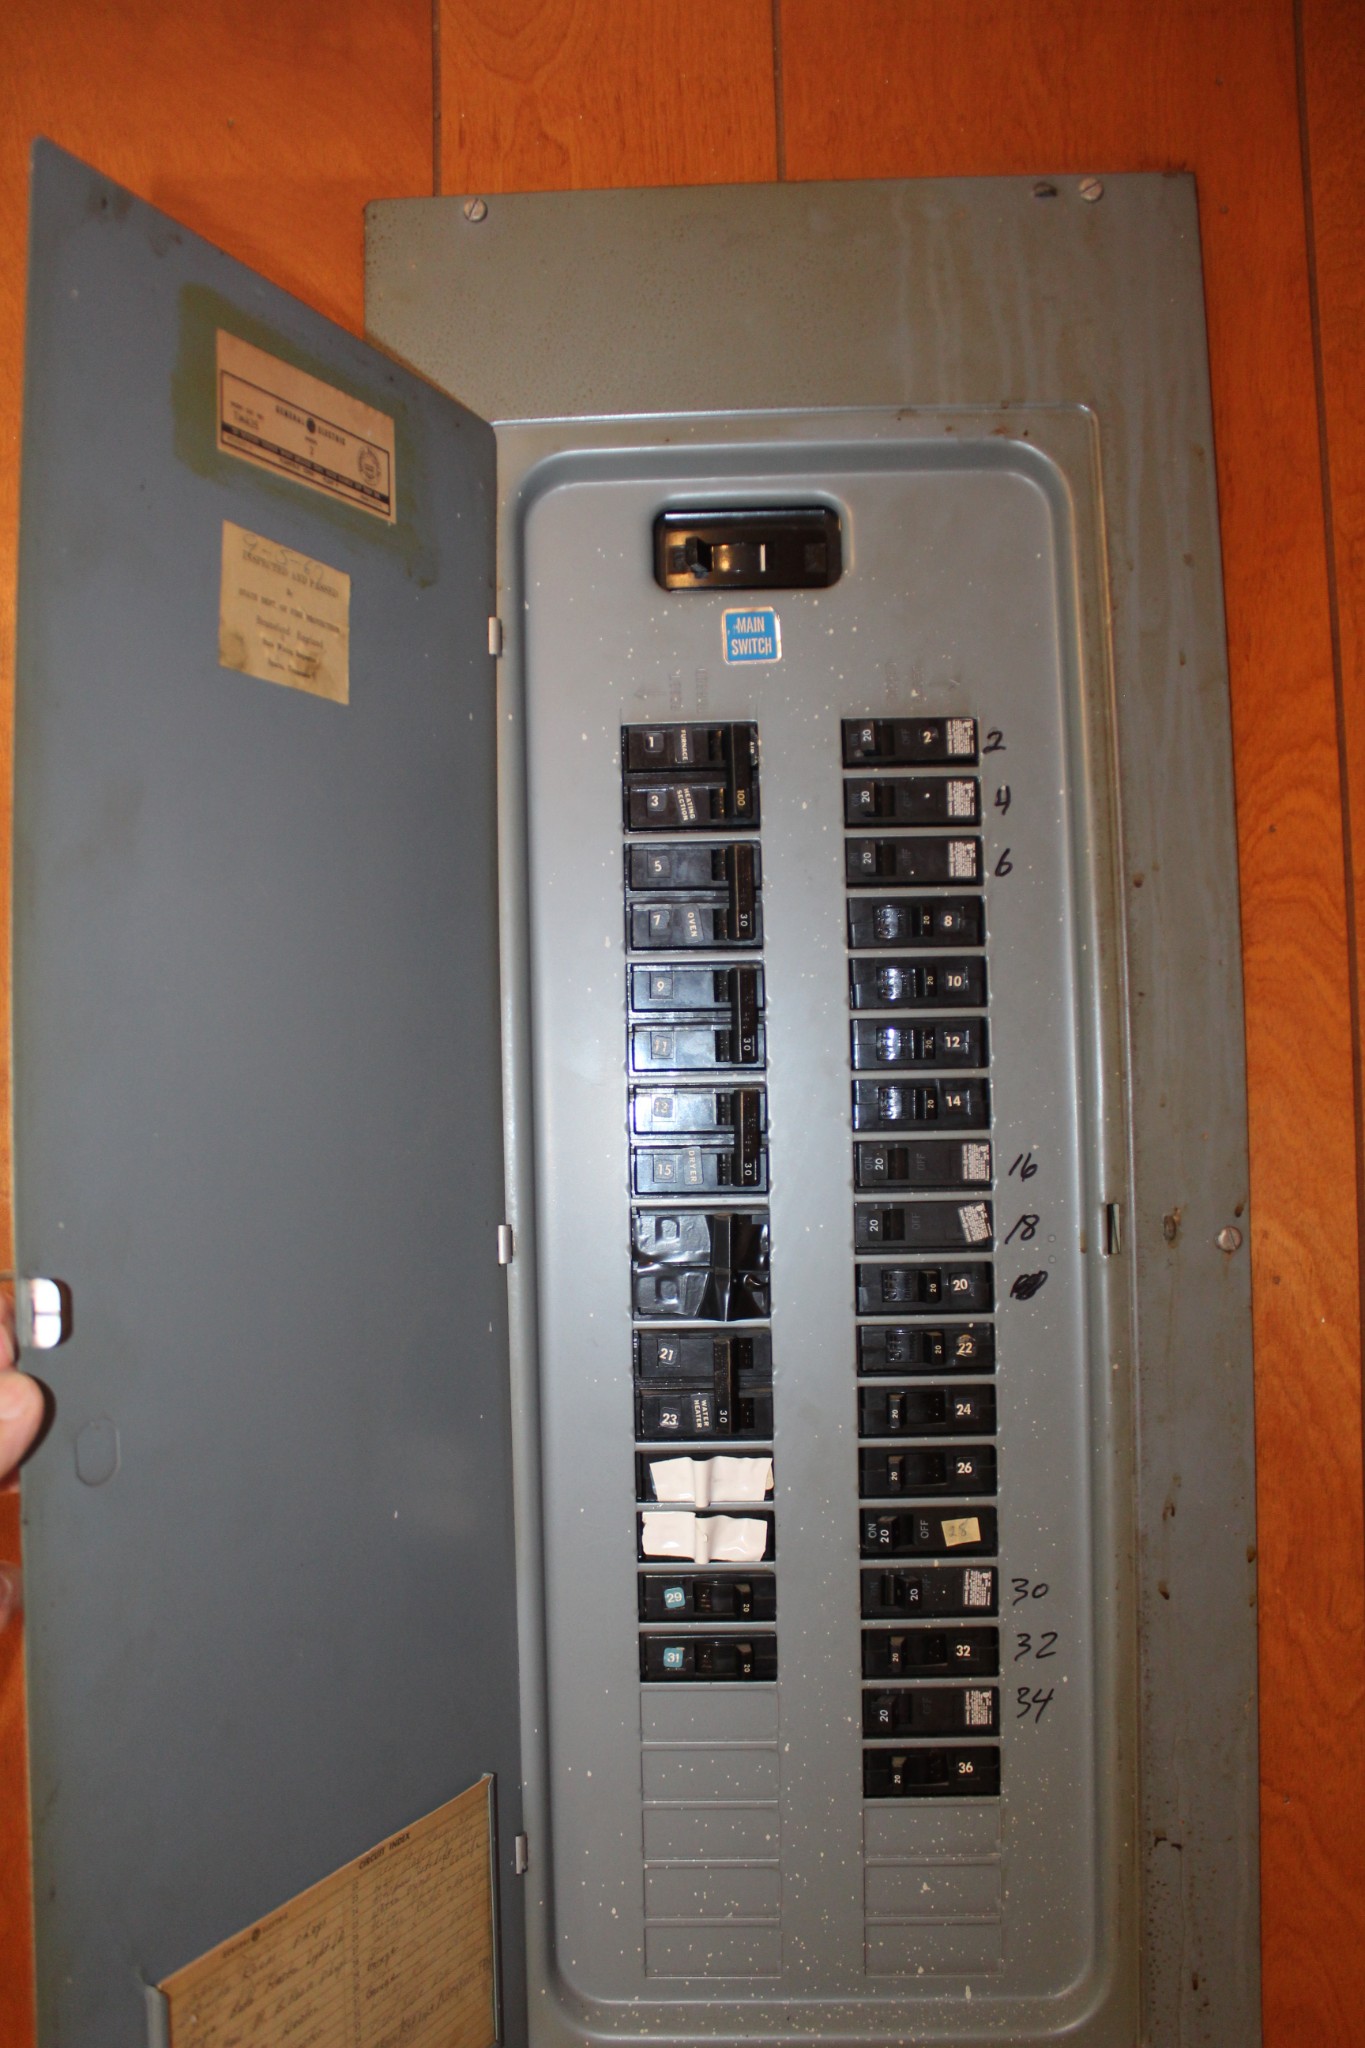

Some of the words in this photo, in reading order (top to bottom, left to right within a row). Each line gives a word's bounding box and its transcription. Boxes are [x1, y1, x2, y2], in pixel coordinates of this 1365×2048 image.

[736, 616, 765, 633] MAIN
[731, 637, 772, 656] SWITCH
[862, 729, 872, 742] 20
[923, 731, 932, 743] 2
[680, 729, 689, 761] FURNACE
[983, 731, 1007, 754] 2
[651, 795, 659, 807] 3
[737, 789, 746, 806] 100
[861, 790, 870, 803] 20
[677, 789, 688, 822] SECTION
[684, 787, 695, 820] HEATING
[863, 852, 872, 864] 20
[994, 848, 1013, 878] 6
[655, 860, 662, 872] 5
[653, 915, 661, 926] 7
[687, 912, 697, 938] OVEN
[740, 913, 748, 927] 30
[924, 915, 931, 925] 20
[944, 916, 953, 927] 8
[927, 975, 934, 985] 20
[947, 976, 962, 987] 10
[656, 981, 665, 992] 9
[743, 1038, 751, 1051] 30
[925, 1039, 933, 1049] 20
[945, 1036, 960, 1048] 12
[927, 1099, 934, 1109] 20
[946, 1095, 961, 1107] 14
[657, 1164, 672, 1176] 15
[688, 1150, 698, 1183] DRYER
[744, 1162, 753, 1176] 30
[875, 1157, 884, 1171] 20
[1008, 1152, 1038, 1182] 16
[869, 1219, 879, 1232] 20
[1004, 1214, 1040, 1245] 18
[930, 1283, 937, 1293] 20
[953, 1279, 968, 1291] 20
[934, 1344, 942, 1354] 20
[958, 1343, 973, 1354] 22
[693, 1399, 702, 1429] HEATER
[701, 1399, 710, 1427] WATER
[892, 1409, 899, 1419] 20
[956, 1404, 971, 1415] 24
[661, 1413, 678, 1425] 23
[719, 1409, 728, 1424] 30
[957, 1462, 972, 1474] 26
[891, 1471, 898, 1481] 20
[868, 1523, 877, 1539] ON
[920, 1519, 929, 1539] OFF
[880, 1529, 889, 1543] 20
[667, 1592, 683, 1603] 29
[910, 1588, 919, 1601] 20
[1011, 1578, 1049, 1606] 30
[743, 1603, 750, 1613] 20
[956, 1645, 971, 1657] 32
[1014, 1631, 1058, 1662] 32
[667, 1652, 680, 1663] 31
[892, 1652, 899, 1662] 20
[744, 1663, 751, 1673] 20
[1016, 1687, 1055, 1724] 34
[879, 1710, 889, 1722] 20
[958, 1761, 974, 1774] 36
[894, 1774, 901, 1784] 20
[358, 1845, 386, 1870] CIRCUIT
[388, 1832, 410, 1850] INDEX
